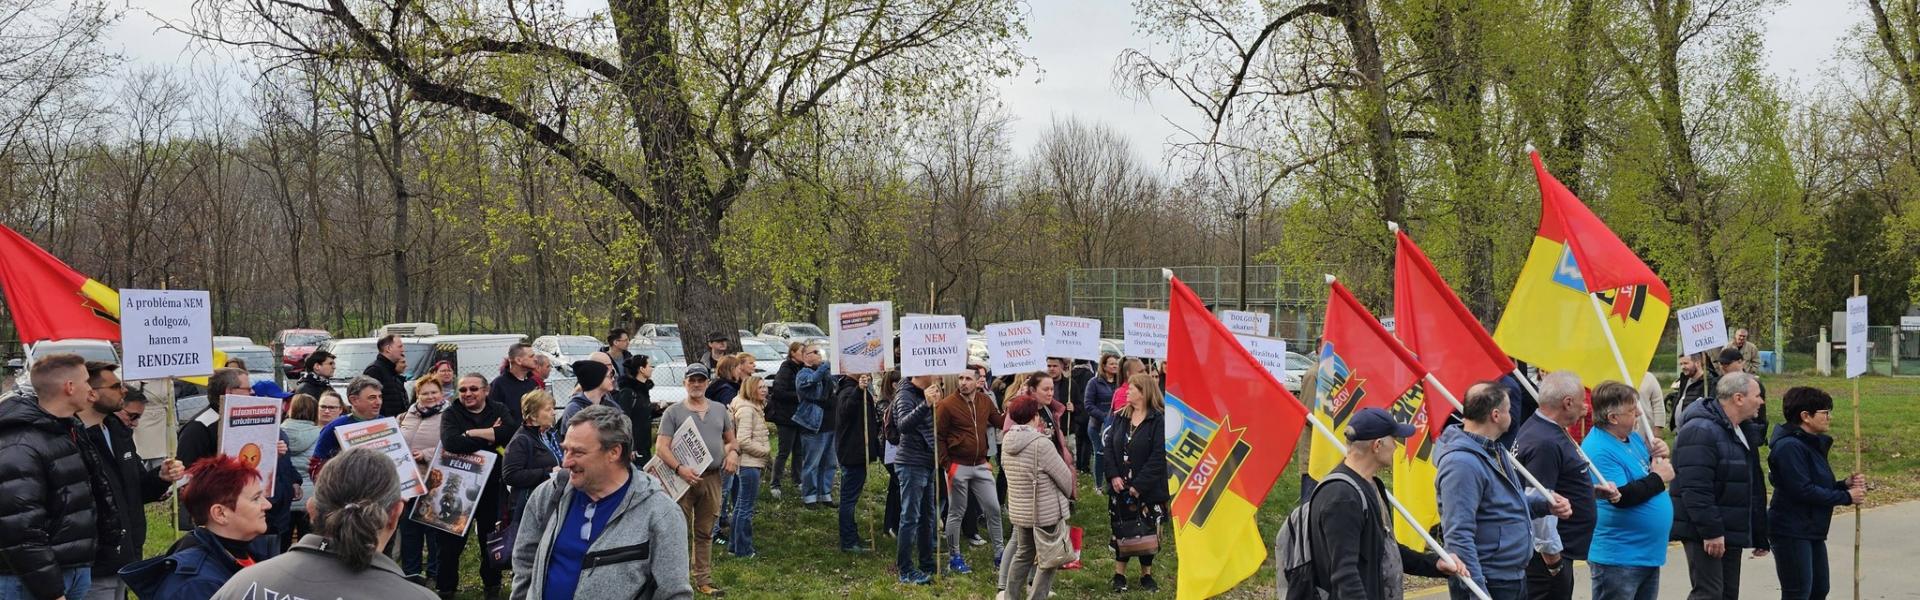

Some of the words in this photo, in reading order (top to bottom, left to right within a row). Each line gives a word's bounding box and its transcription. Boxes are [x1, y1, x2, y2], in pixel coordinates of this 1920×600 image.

[126, 297, 133, 308] A
[136, 297, 181, 310] probléma
[182, 298, 203, 308] NEM
[152, 315, 191, 329] dolgozó,
[1692, 321, 1714, 333] NINCS
[1008, 327, 1032, 336] NINCS
[149, 335, 181, 345] hanem
[183, 336, 188, 344] a
[924, 333, 946, 343] NEM
[1006, 348, 1031, 358] NINCS
[138, 353, 200, 367] RENDSZER
[924, 359, 947, 367] UTCA
[688, 427, 696, 438] MIT
[449, 459, 472, 471] FÉLNI
